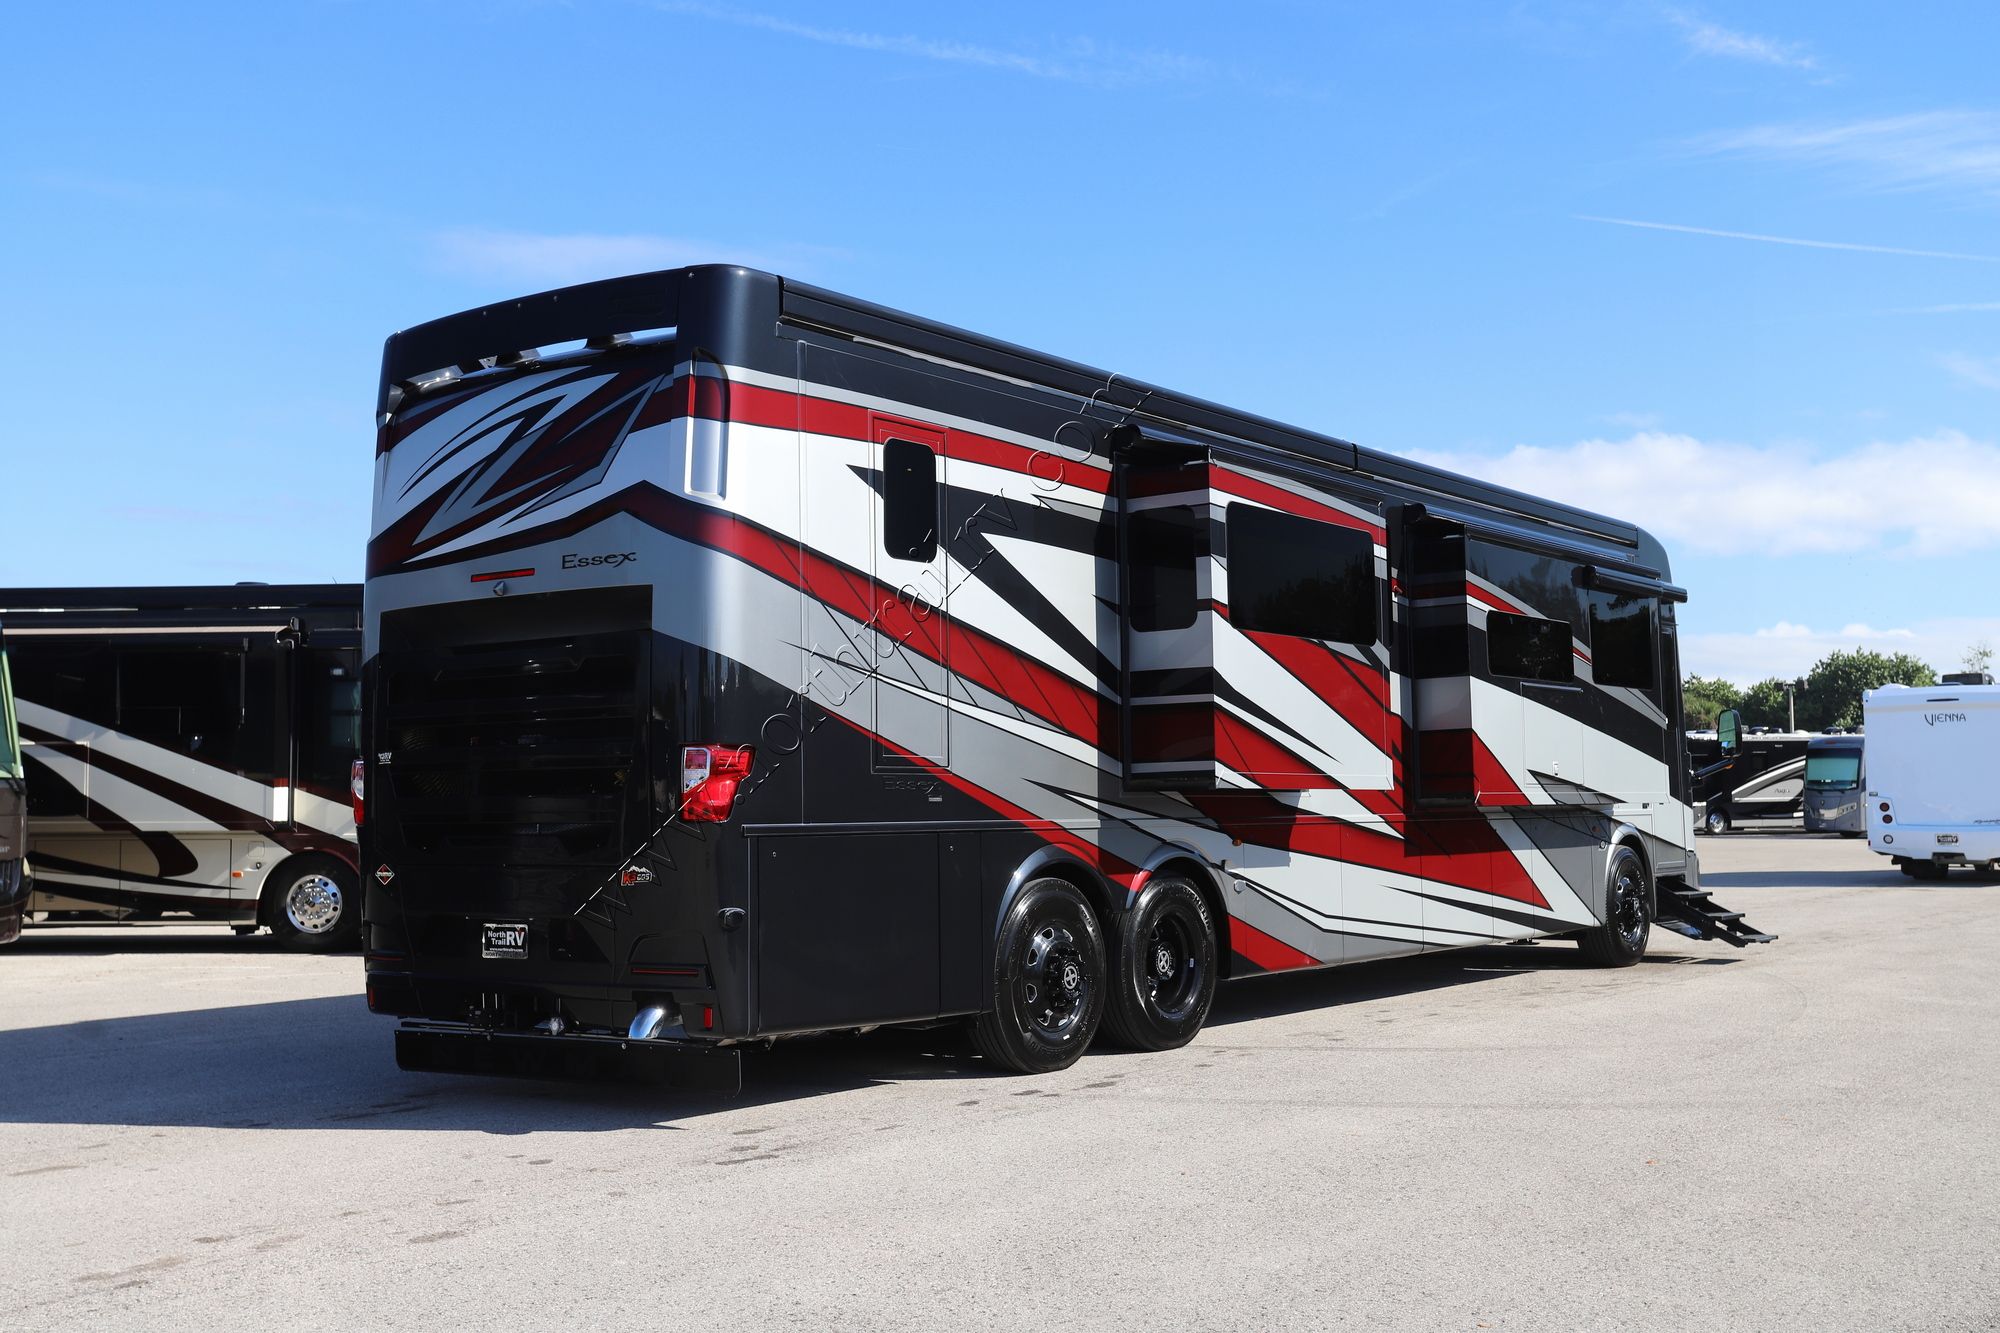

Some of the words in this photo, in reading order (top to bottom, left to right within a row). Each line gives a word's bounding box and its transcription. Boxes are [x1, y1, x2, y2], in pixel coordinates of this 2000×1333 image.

[561, 551, 637, 570] Essex
[487, 930, 506, 938] North
[506, 931, 525, 945] RV
